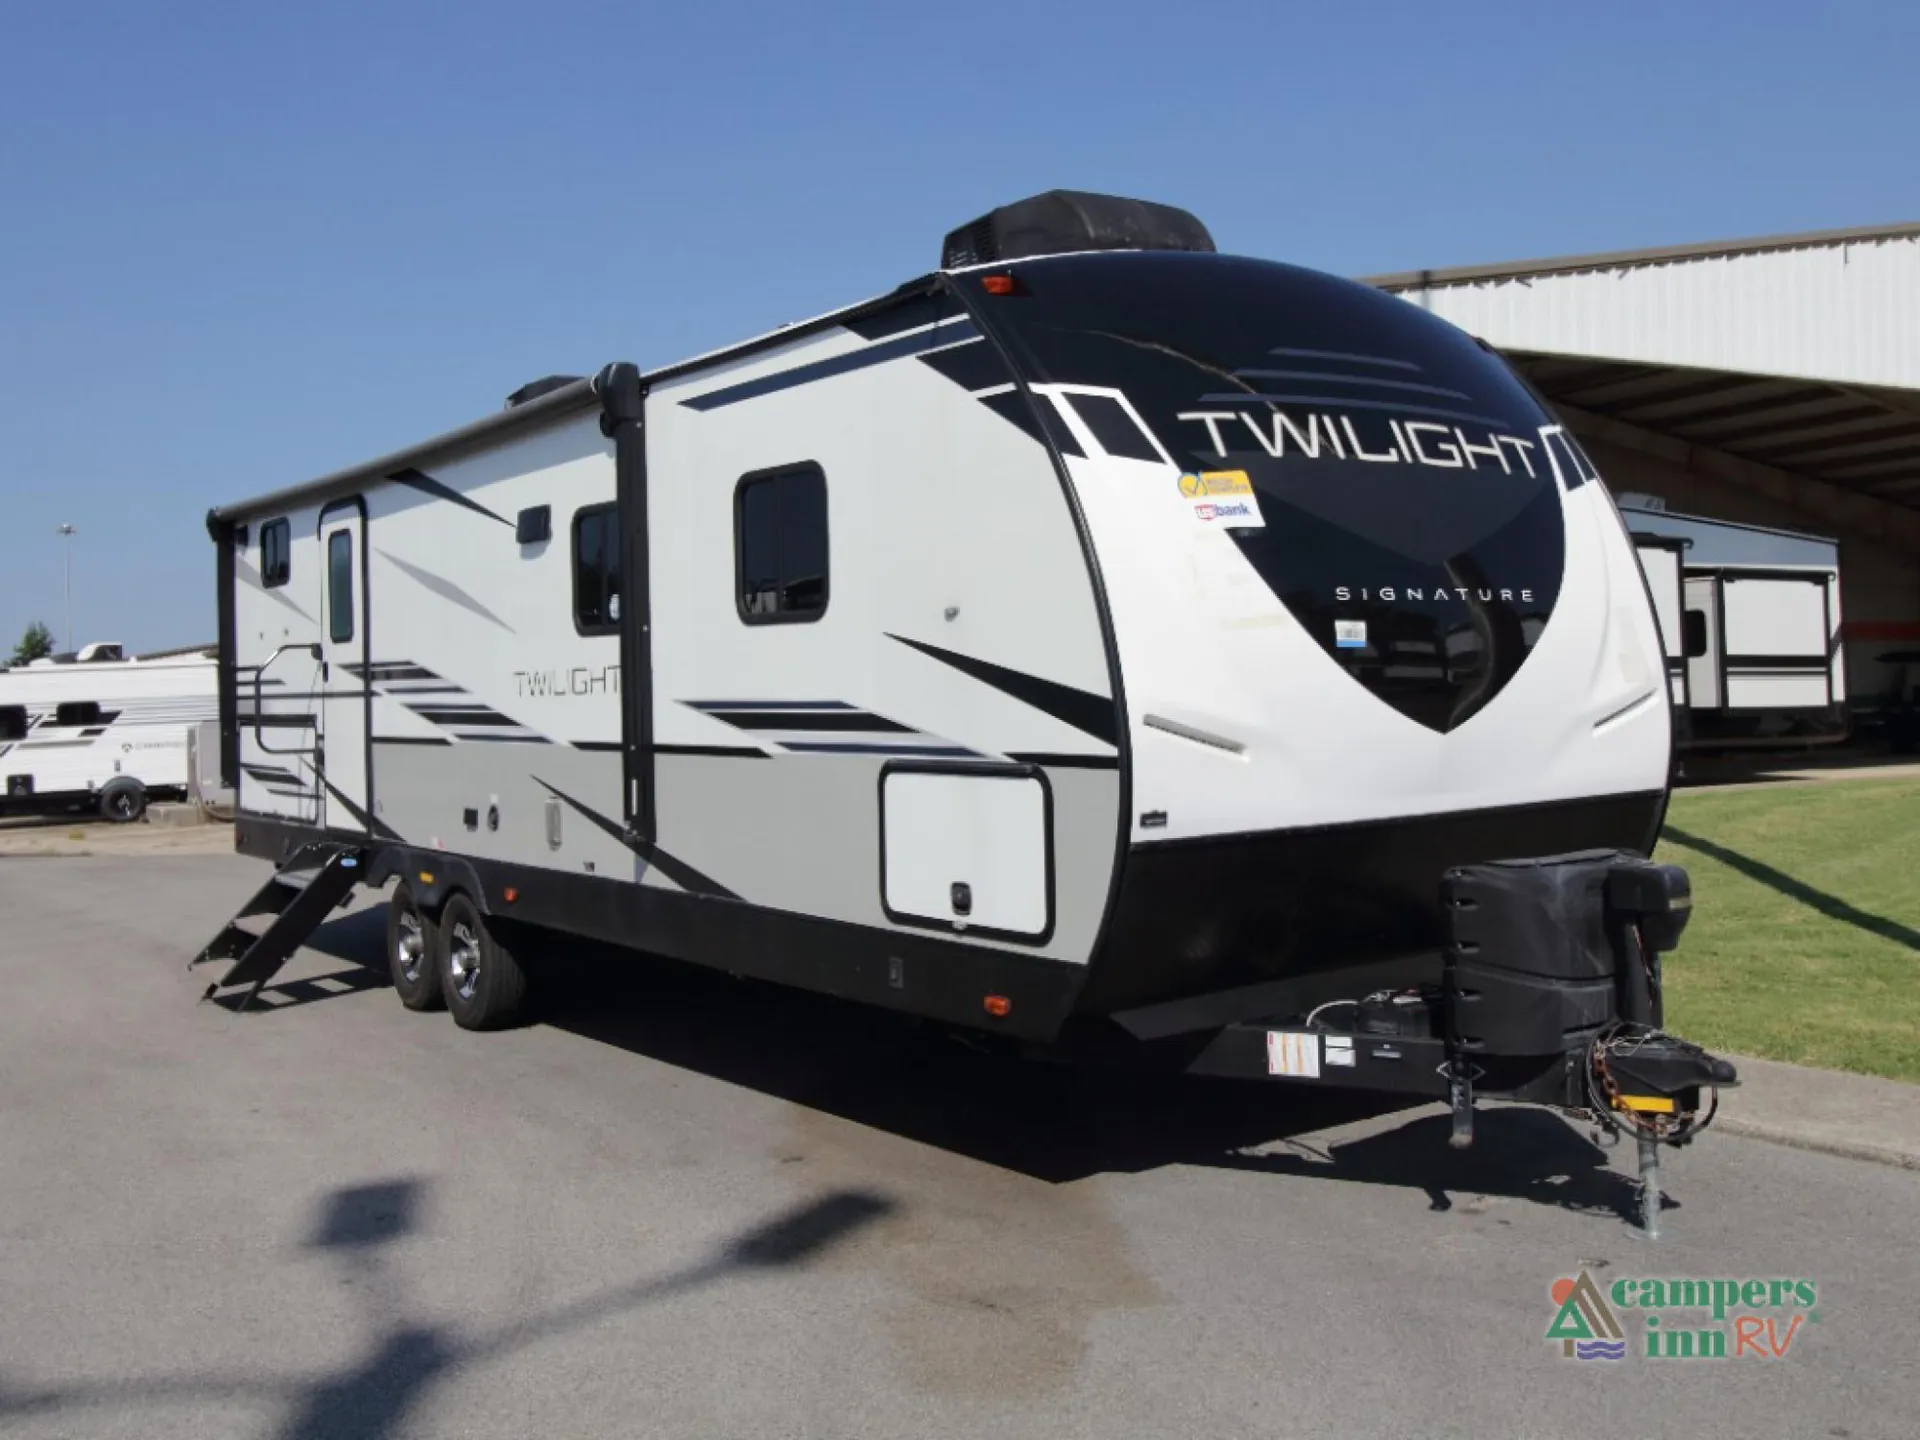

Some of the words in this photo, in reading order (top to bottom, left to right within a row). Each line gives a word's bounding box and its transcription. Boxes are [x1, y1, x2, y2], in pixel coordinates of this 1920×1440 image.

[1177, 410, 1536, 478] TWILIGHT
[1335, 586, 1534, 602] SIGNATURE
[513, 665, 622, 698] TWILIGHT
